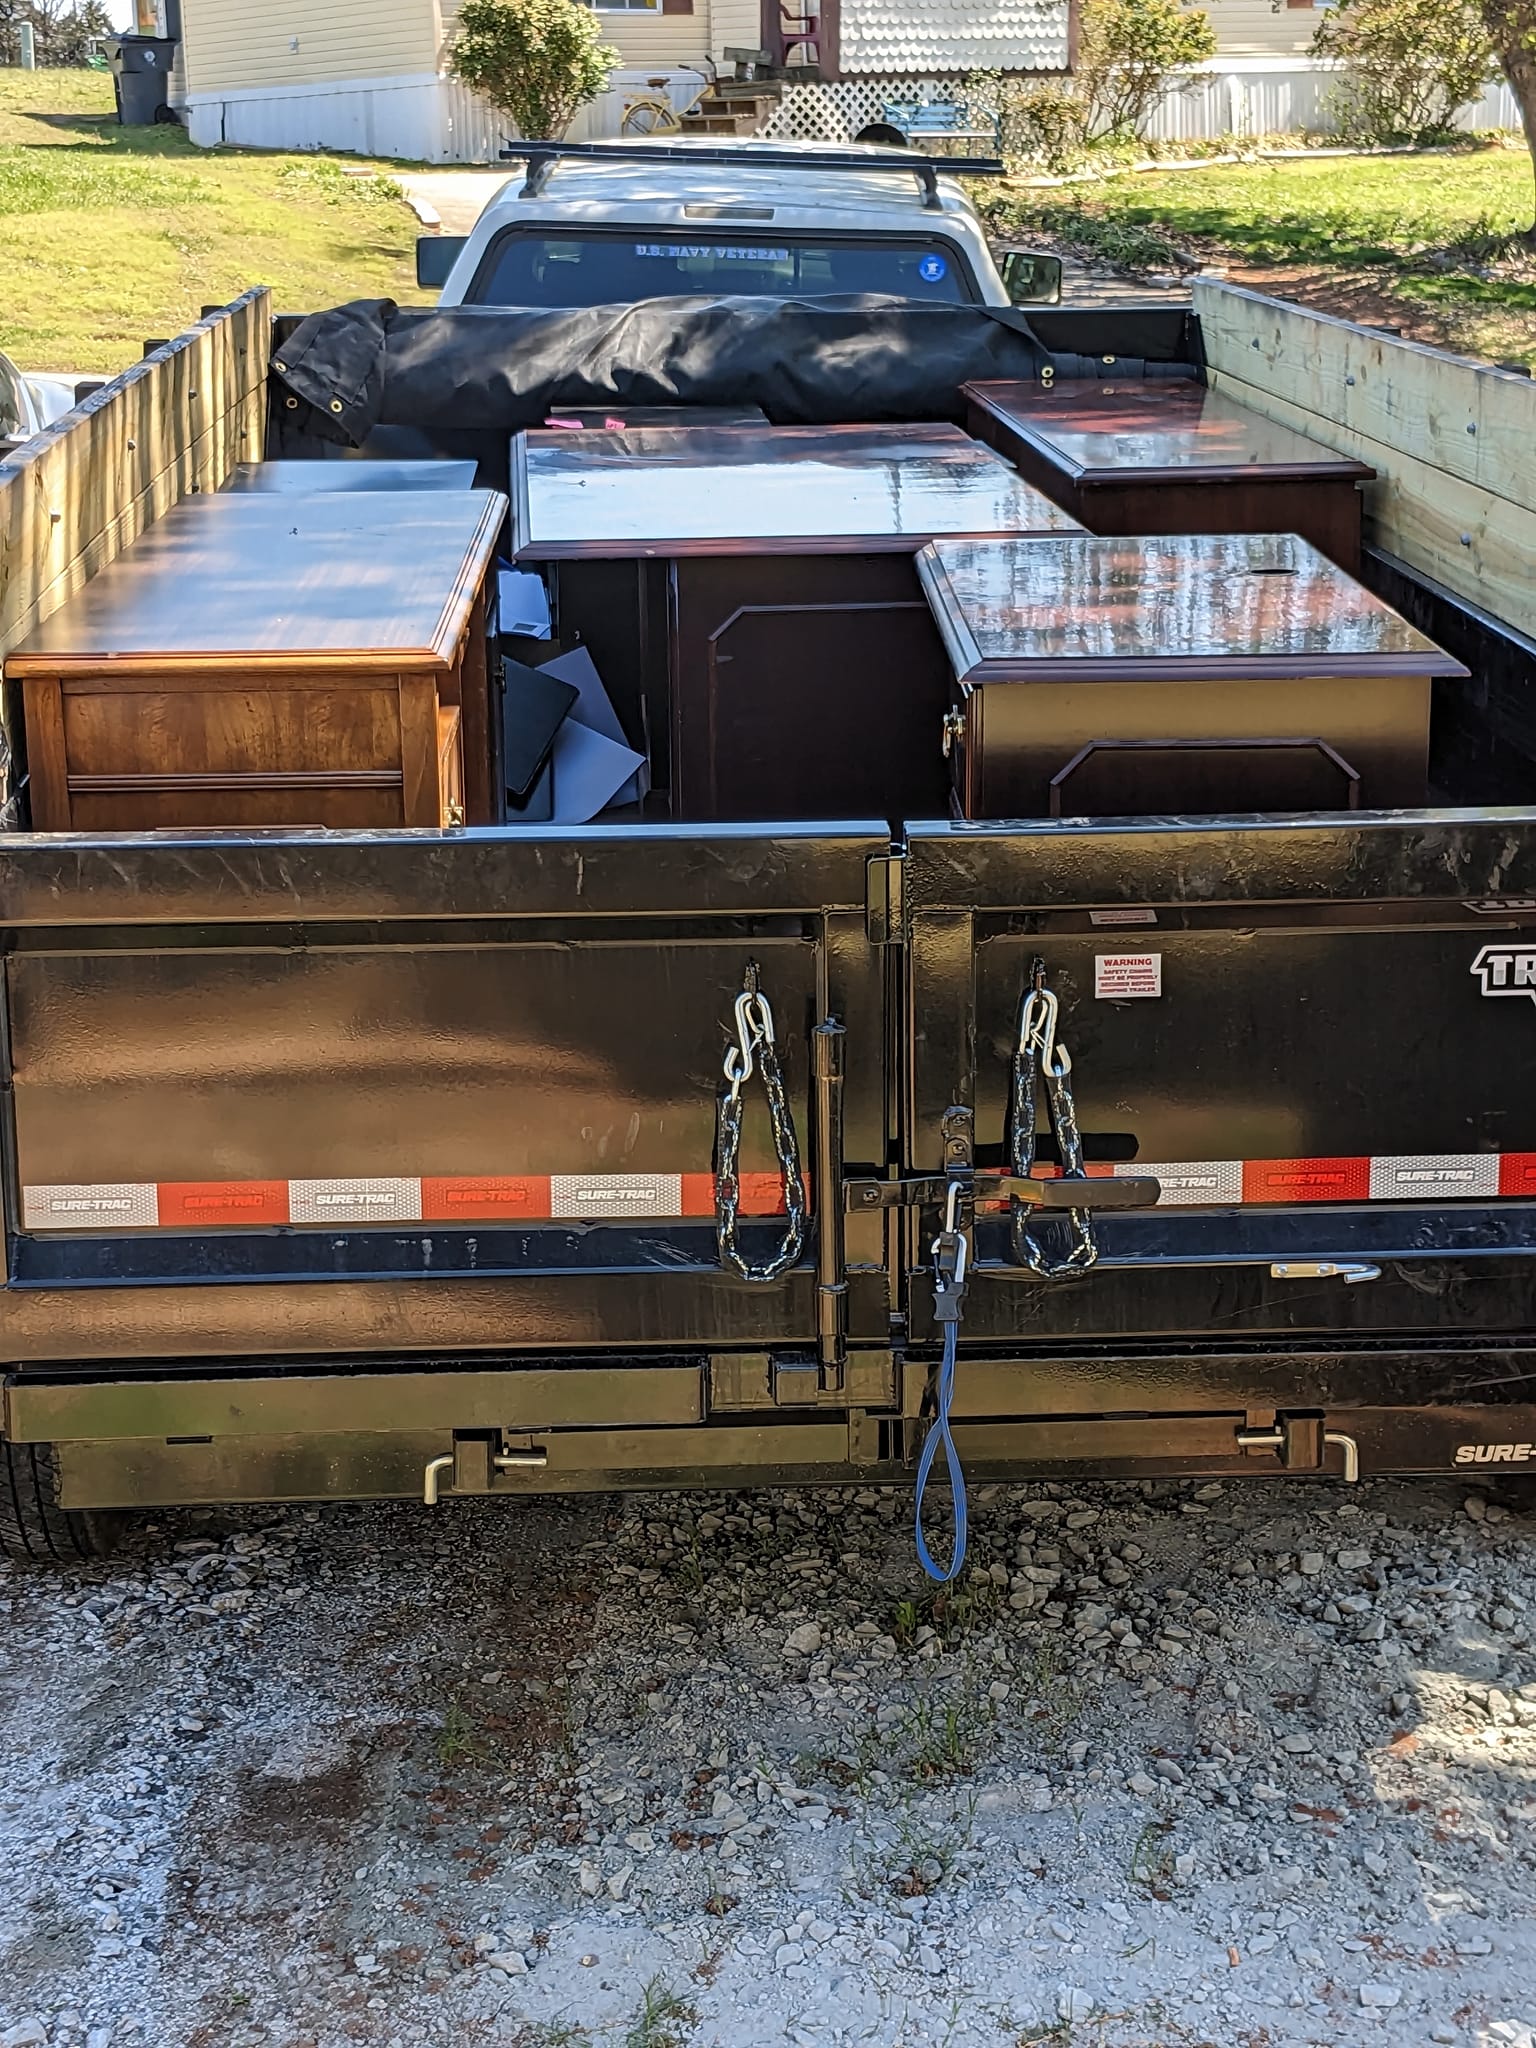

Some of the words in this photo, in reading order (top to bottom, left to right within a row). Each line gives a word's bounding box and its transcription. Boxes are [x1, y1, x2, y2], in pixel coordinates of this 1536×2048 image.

[635, 245, 665, 257] U.S.
[669, 246, 711, 258] NAVY
[716, 248, 789, 261] VETERAN
[1103, 958, 1152, 967] WARNING
[1396, 1170, 1474, 1182] SURE-TRAC
[1160, 1177, 1217, 1188] RE-TRAC
[316, 1193, 396, 1205] SURE-TRAC
[577, 1189, 656, 1201] SURE-TRAC
[51, 1200, 132, 1211] SURE-TRAC
